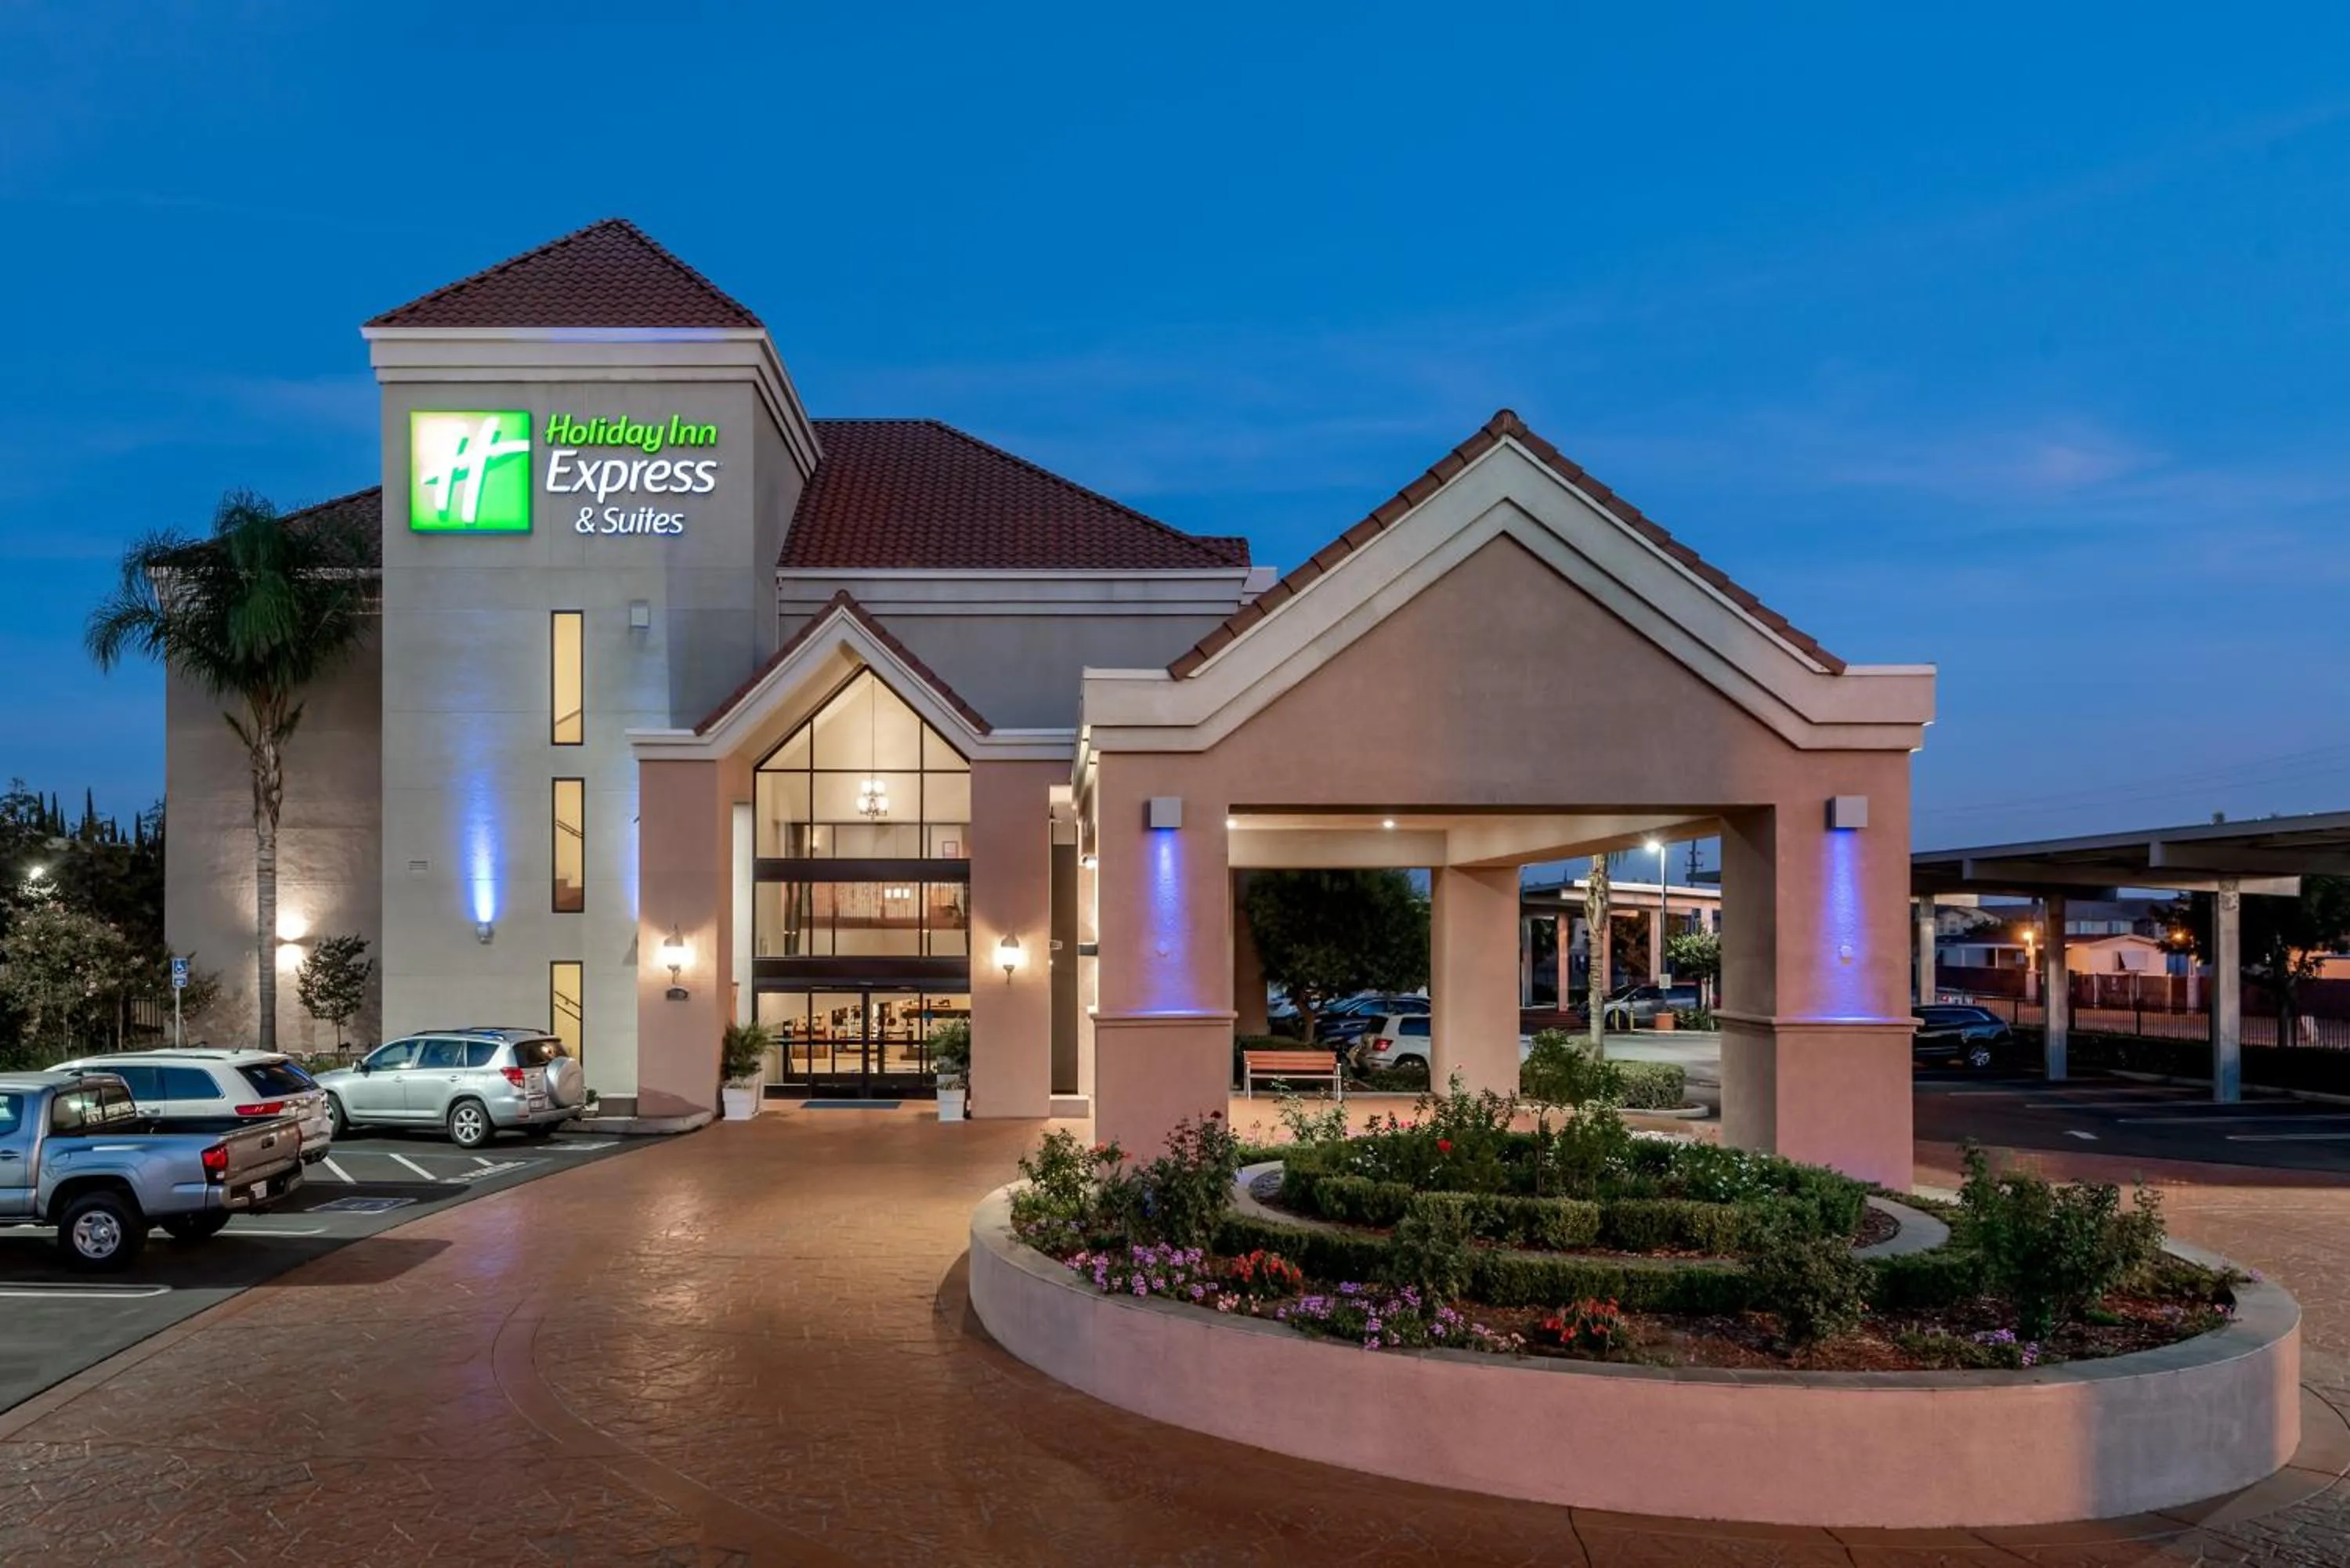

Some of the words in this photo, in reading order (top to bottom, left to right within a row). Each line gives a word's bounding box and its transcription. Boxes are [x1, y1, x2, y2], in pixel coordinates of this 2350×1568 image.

[546, 414, 663, 452] Holiday
[669, 414, 717, 446] Inn
[546, 450, 716, 503] Express
[575, 507, 595, 533] &
[601, 507, 684, 533] Suites
